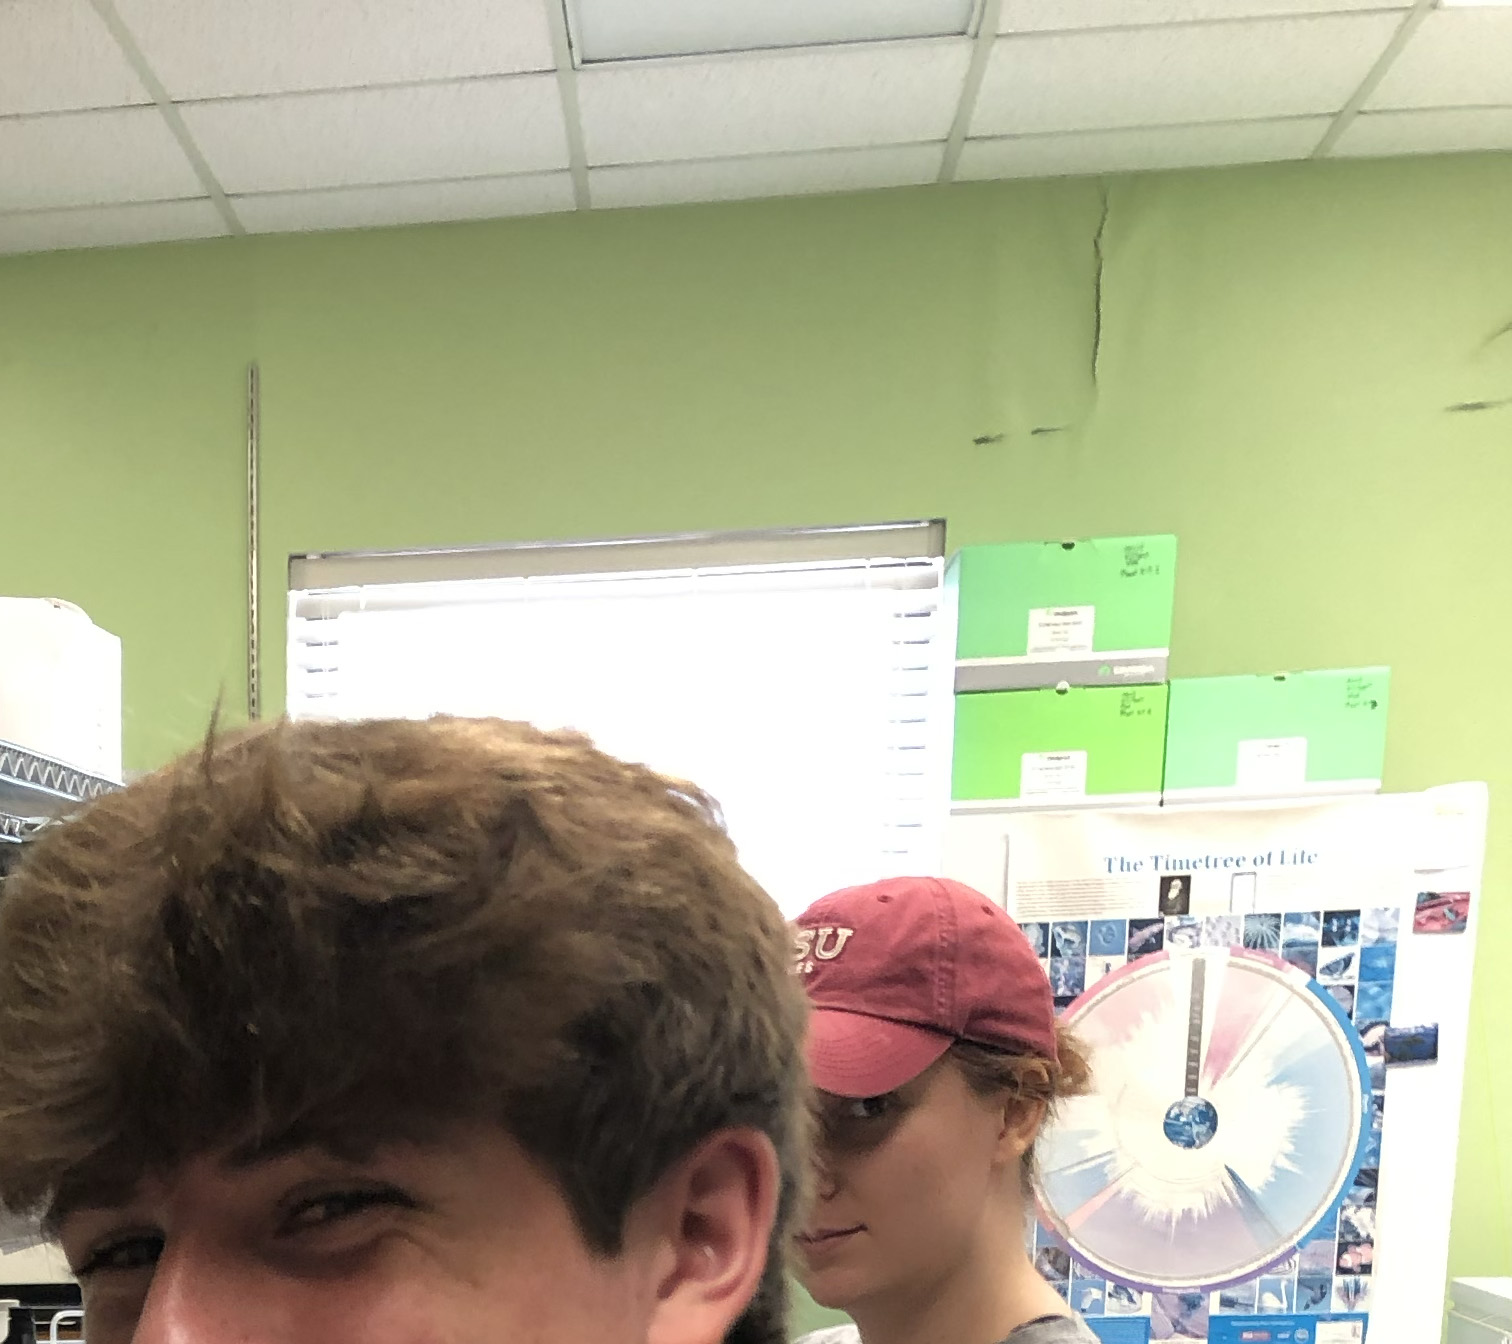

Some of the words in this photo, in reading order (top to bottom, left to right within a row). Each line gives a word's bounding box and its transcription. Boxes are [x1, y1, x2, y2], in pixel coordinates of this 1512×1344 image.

[1104, 856, 1144, 873] The
[1150, 854, 1246, 872] Timetree
[1253, 851, 1272, 867] of
[1280, 848, 1318, 866] Life
[793, 927, 854, 961] SU
